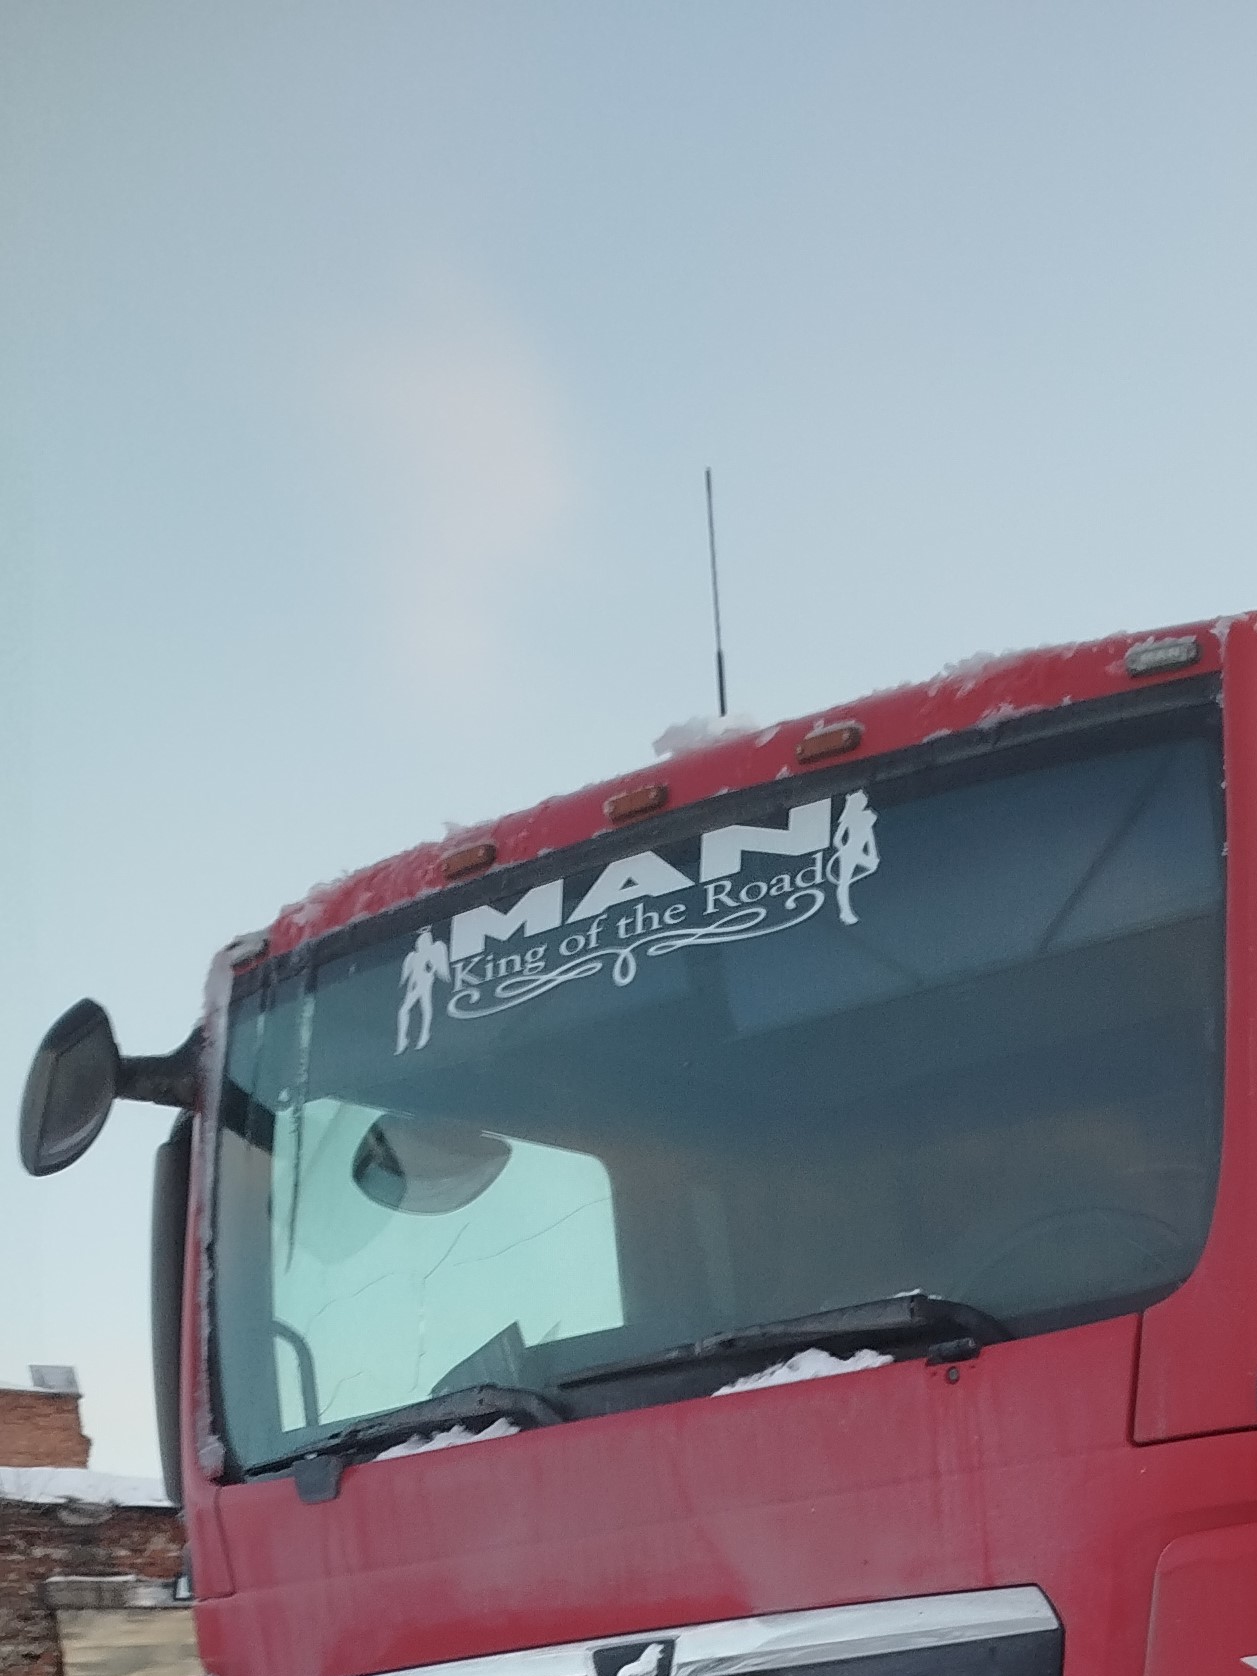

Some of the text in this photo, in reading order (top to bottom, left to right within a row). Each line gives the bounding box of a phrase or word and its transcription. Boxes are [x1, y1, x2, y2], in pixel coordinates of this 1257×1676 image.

[450, 797, 832, 962] MAN
[450, 851, 825, 993] King of the Road
